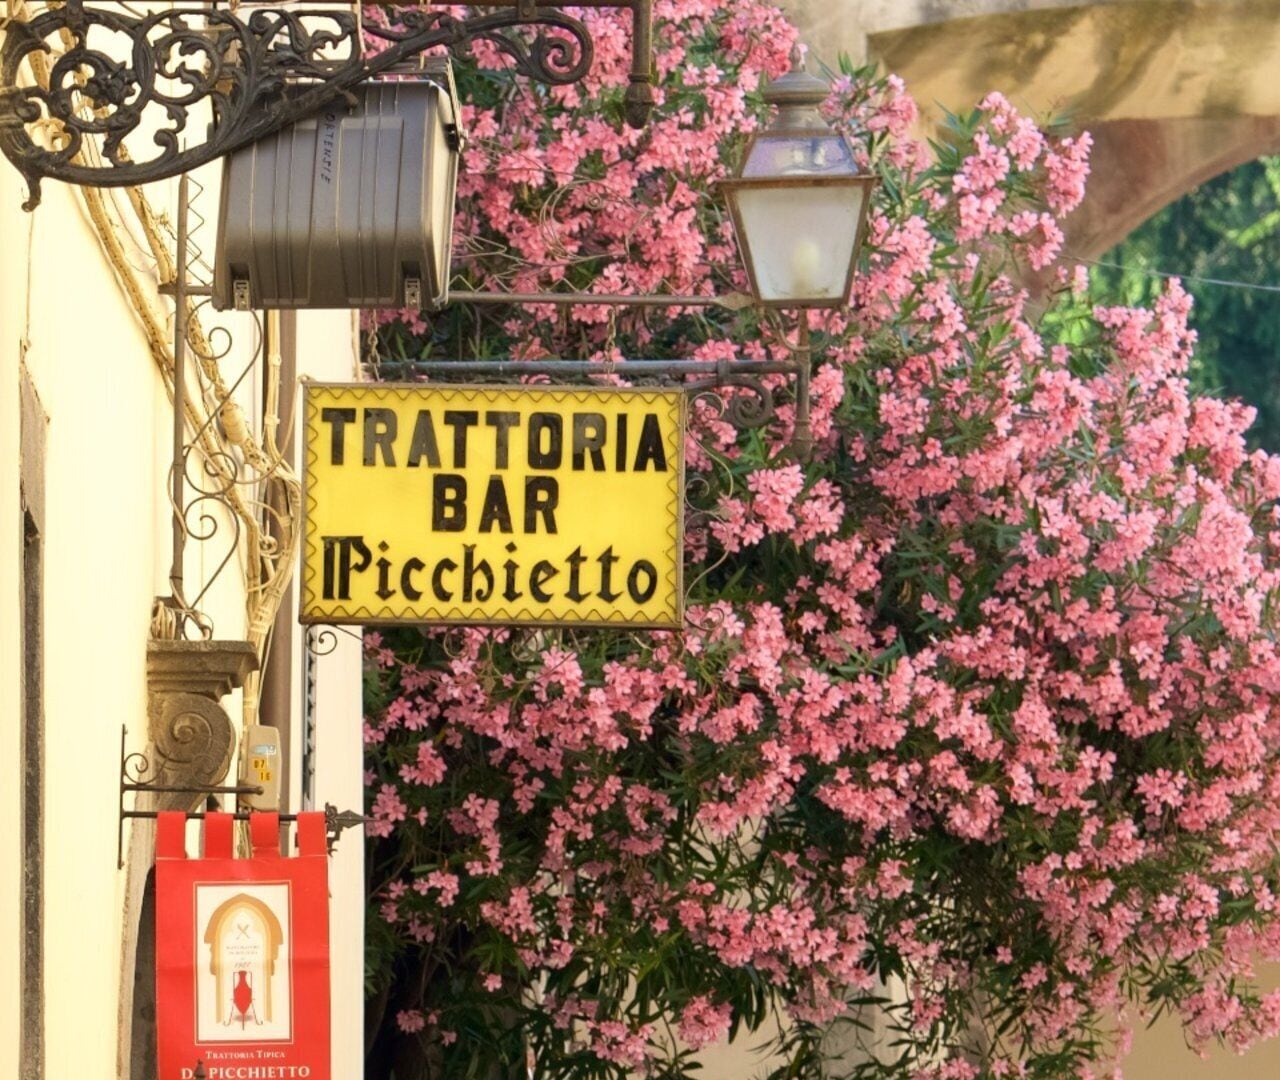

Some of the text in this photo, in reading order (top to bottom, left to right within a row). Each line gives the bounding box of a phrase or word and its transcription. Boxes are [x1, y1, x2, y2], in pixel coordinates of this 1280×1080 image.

[321, 407, 667, 473] TRATTORIA
[432, 473, 559, 535] BAR
[321, 536, 658, 605] Picchietto
[209, 1066, 310, 1080] PICCHIETTO
